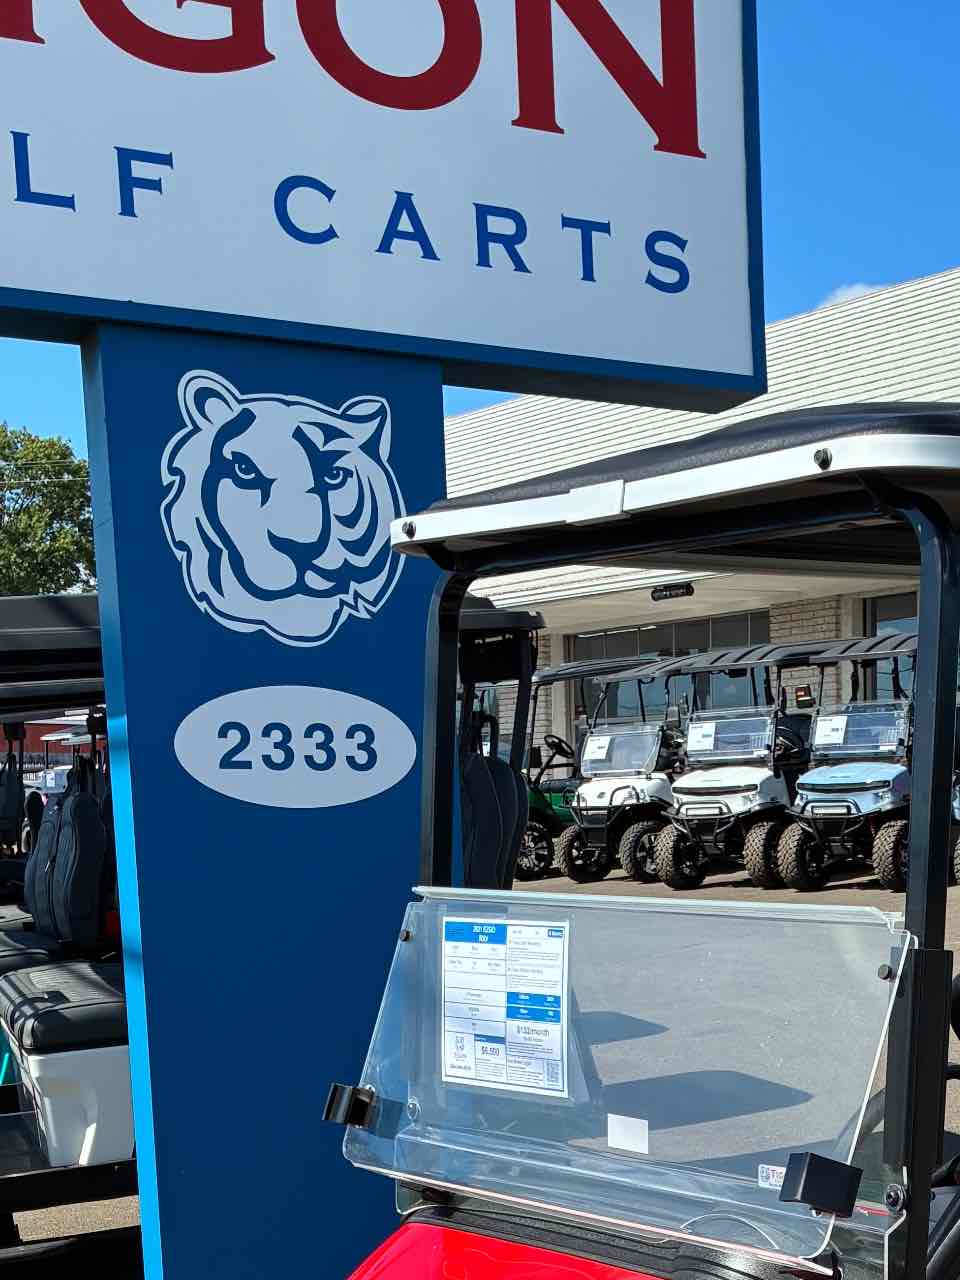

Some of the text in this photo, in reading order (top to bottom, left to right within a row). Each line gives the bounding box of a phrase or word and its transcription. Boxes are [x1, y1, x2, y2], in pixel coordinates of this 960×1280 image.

[0, 0, 706, 159] GON
[273, 174, 691, 294] CARTS
[216, 720, 378, 772] 2333
